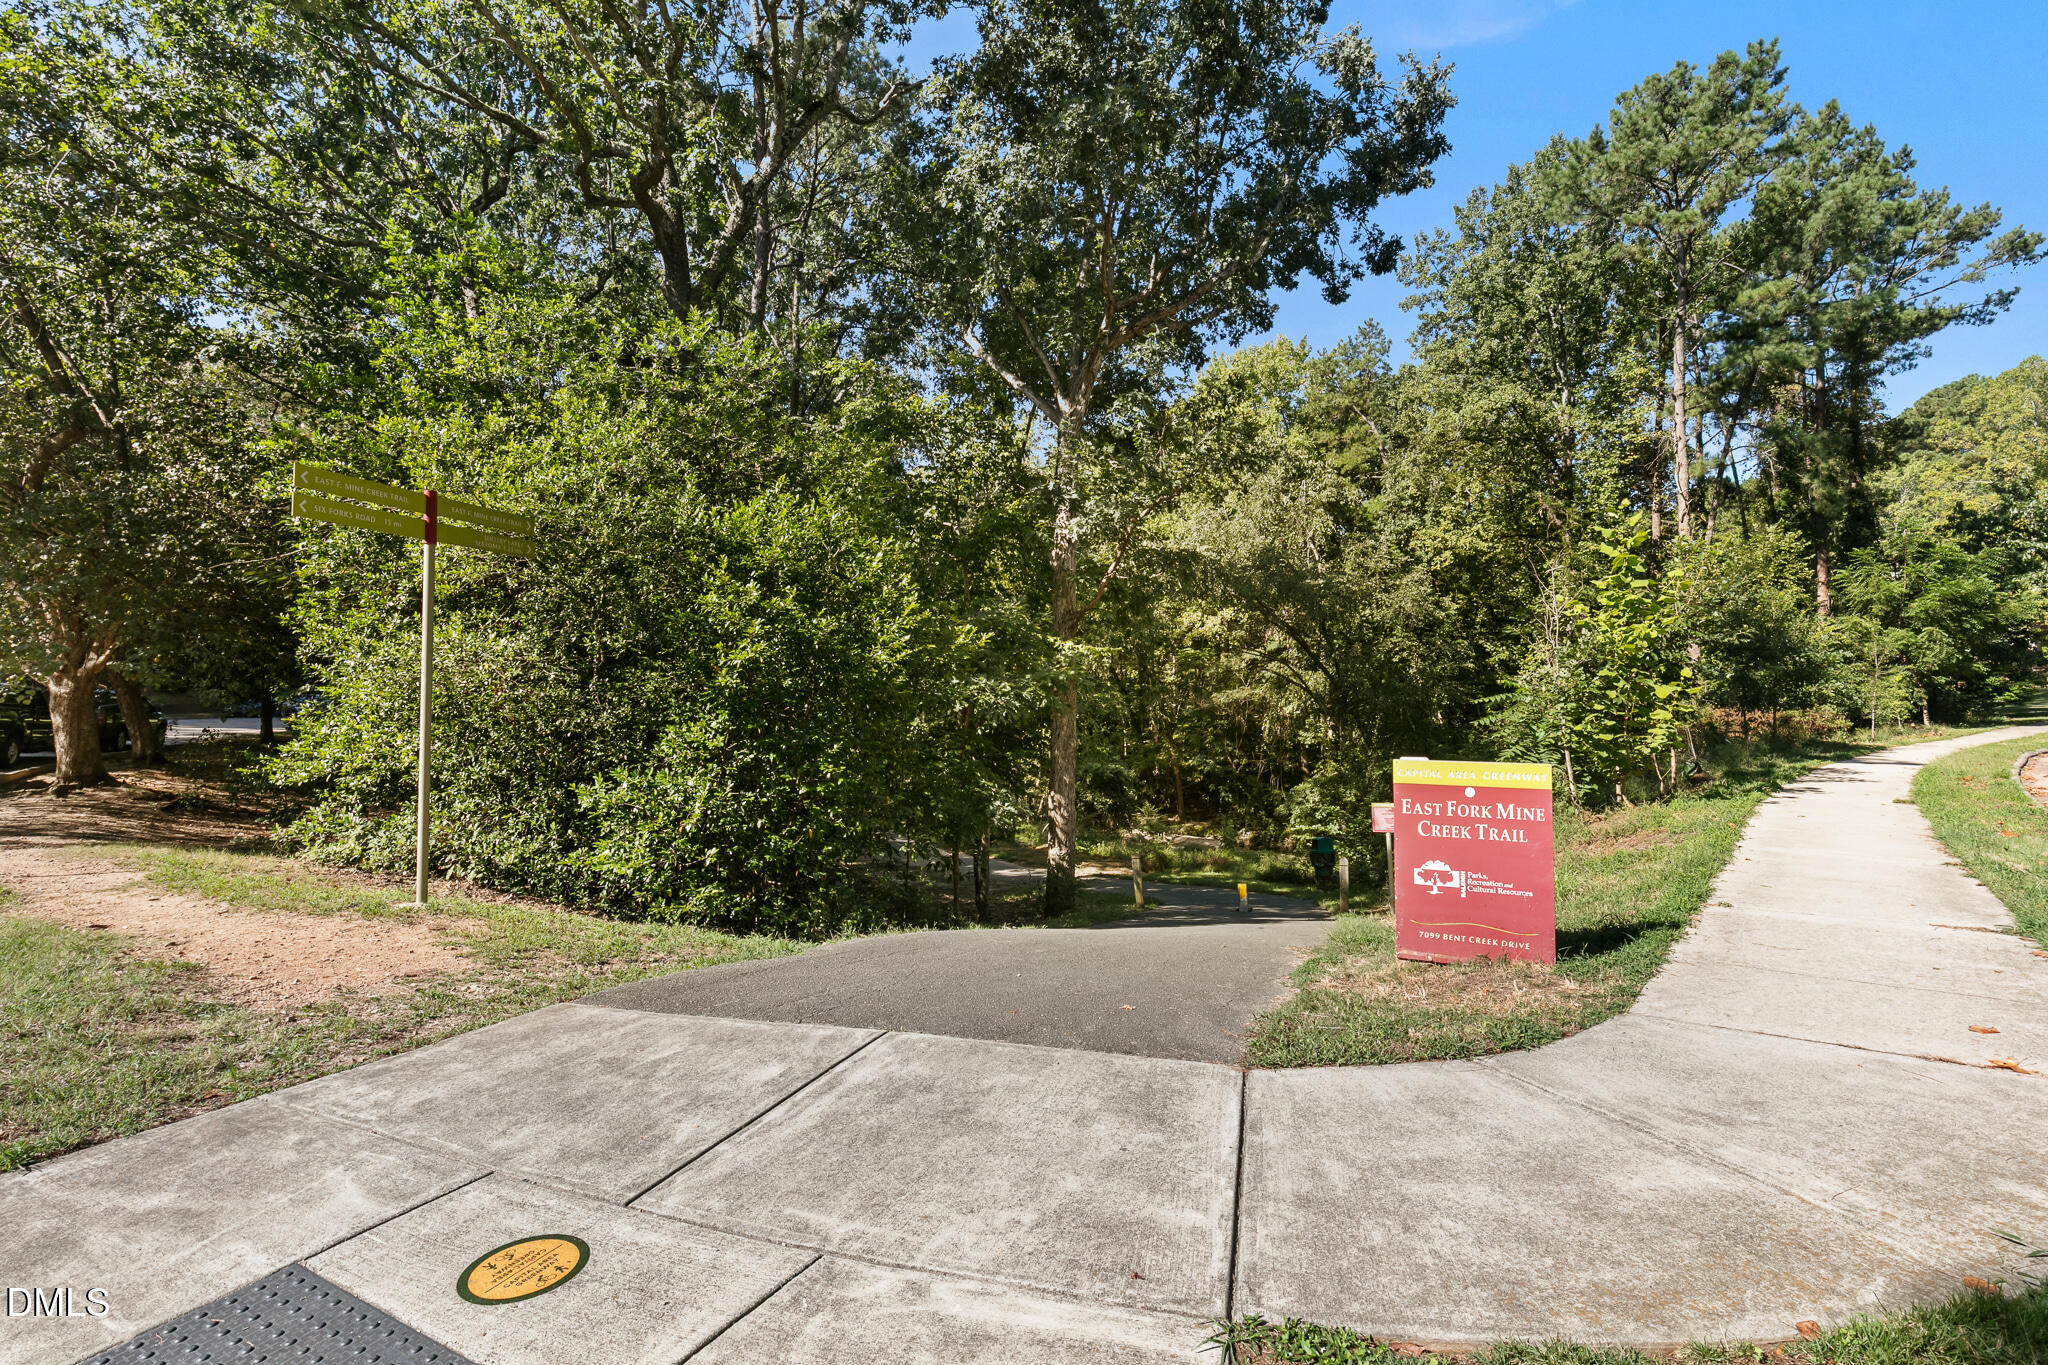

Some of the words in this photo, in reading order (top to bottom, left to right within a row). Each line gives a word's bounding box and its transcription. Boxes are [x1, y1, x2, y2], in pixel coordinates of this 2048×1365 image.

[315, 476, 334, 486] EAST
[344, 483, 364, 493] MINE
[366, 488, 388, 498] CREEK
[390, 493, 408, 503] TRAIL
[314, 504, 326, 513] SIX
[328, 506, 353, 518] FORKS
[356, 513, 376, 523] ROAD
[1397, 769, 1442, 778] CAPITAL
[1448, 770, 1476, 780] AREA
[1482, 771, 1548, 782] GREENWAY
[1400, 798, 1442, 816] EAST
[1446, 800, 1492, 818] FORK
[1496, 802, 1546, 822] MINE
[1417, 820, 1471, 840] CREEK
[1474, 824, 1528, 842] TRAIL
[1467, 871, 1488, 880] Parks,
[1467, 879, 1504, 888] Recreation
[1467, 886, 1496, 894] Cultural
[1498, 888, 1533, 897] Resources
[1418, 931, 1440, 939] 7099
[1443, 934, 1466, 942] BENT
[1468, 936, 1498, 946] CREEK
[1501, 940, 1530, 949] DRIVE
[504, 1267, 537, 1288] CAPITAL
[538, 1253, 558, 1266] AREA
[516, 1258, 558, 1286] GREENWAY
